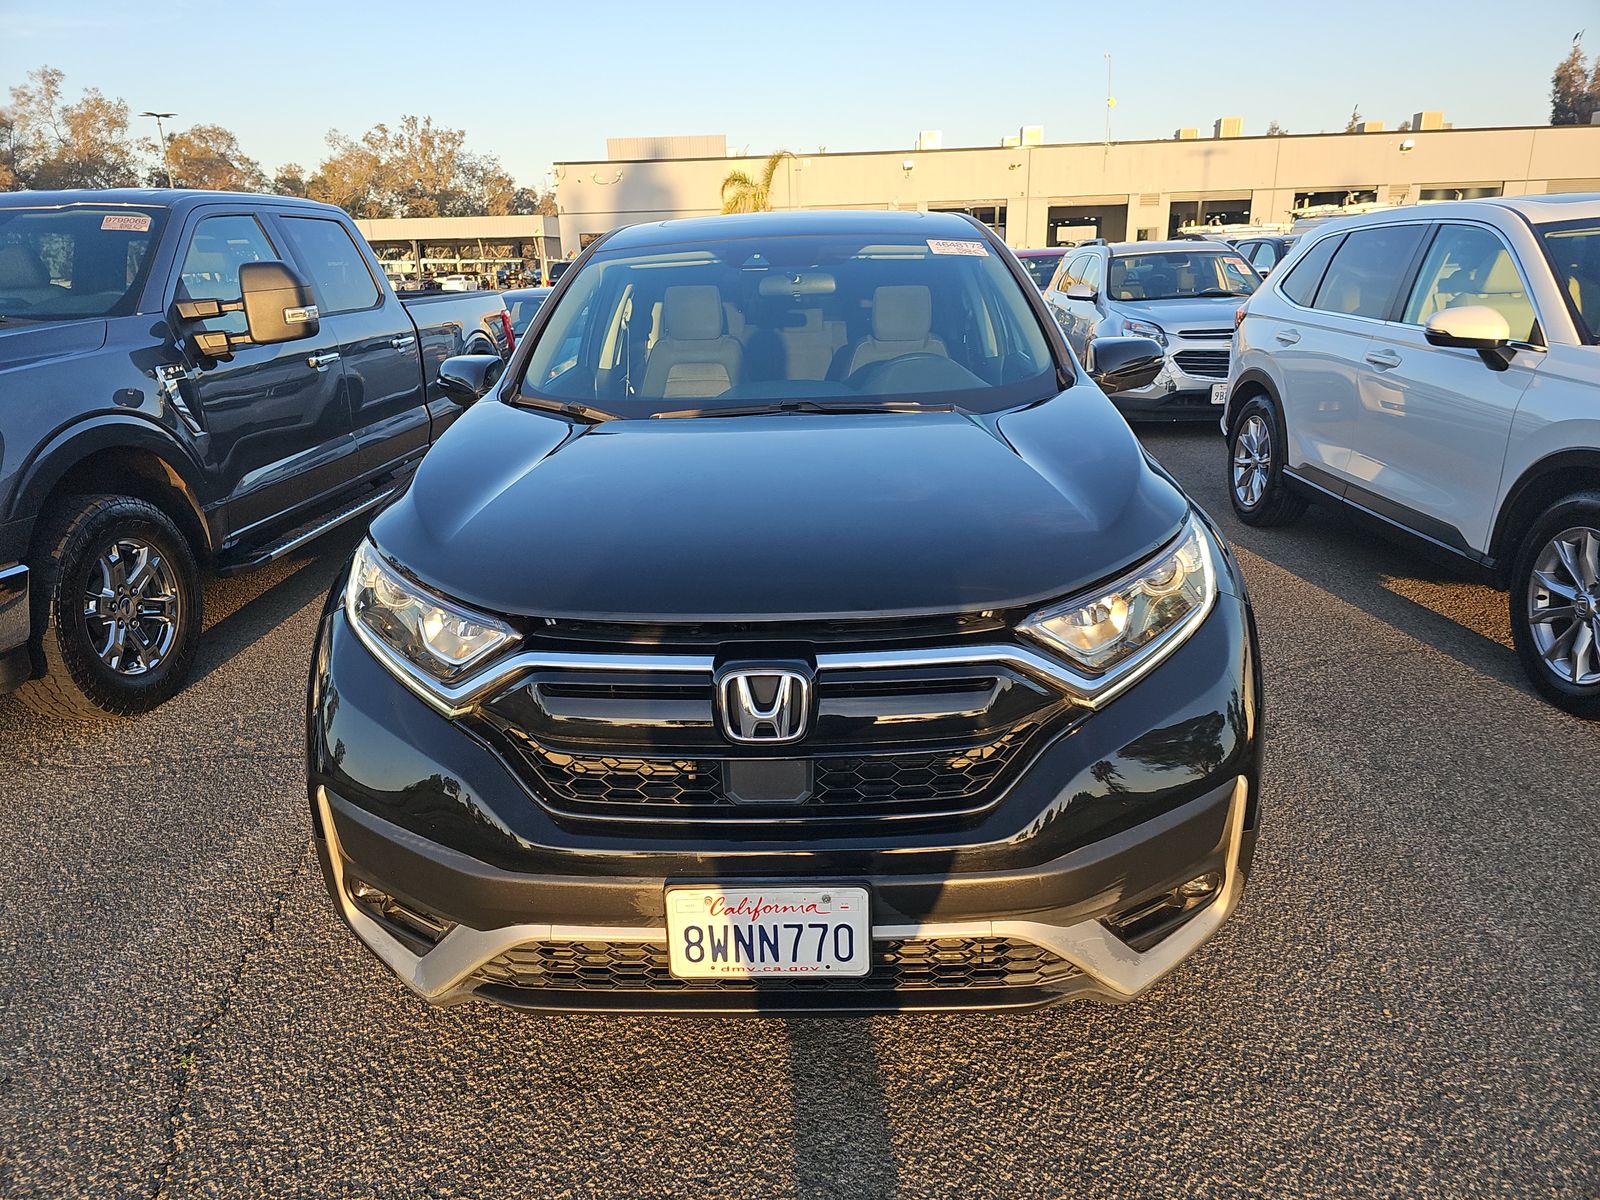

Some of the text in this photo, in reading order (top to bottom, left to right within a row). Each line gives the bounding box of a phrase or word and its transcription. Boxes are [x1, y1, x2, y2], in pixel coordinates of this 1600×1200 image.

[1214, 391, 1226, 401] 9B
[709, 896, 831, 922] California
[683, 923, 854, 963] 8WNN770
